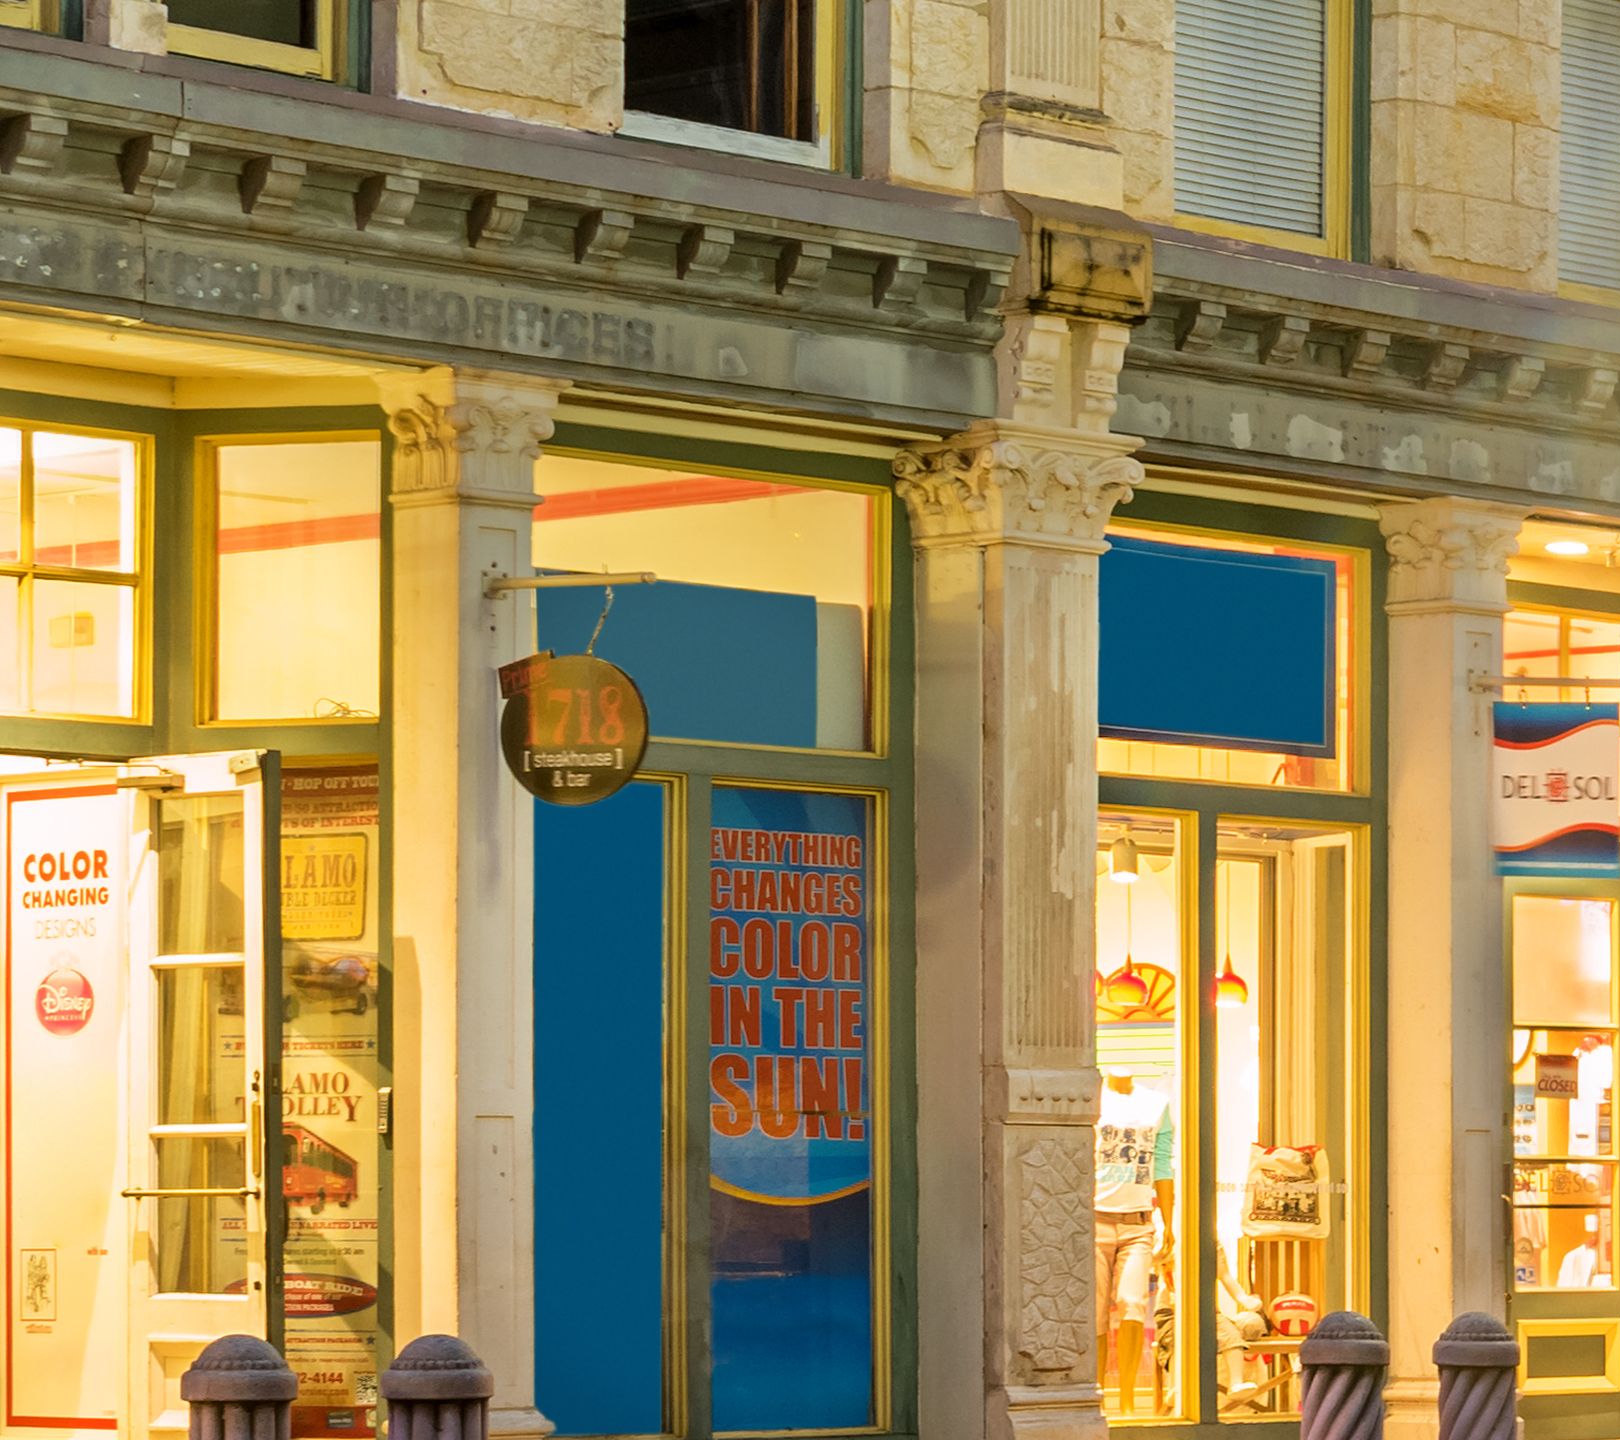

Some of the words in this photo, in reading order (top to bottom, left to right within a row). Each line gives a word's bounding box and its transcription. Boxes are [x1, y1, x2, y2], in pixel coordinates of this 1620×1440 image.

[525, 685, 624, 745] 1718
[324, 777, 349, 789] OFF
[553, 771, 563, 786] &
[566, 772, 592, 786] bar
[1502, 774, 1541, 799] DEL
[1573, 775, 1616, 801] SOL
[710, 828, 862, 868] EVERYTHING
[24, 850, 109, 882] COLOR
[284, 854, 356, 888] LAMO
[23, 887, 109, 909] CHANGING
[710, 868, 862, 917] CHANGES
[35, 917, 96, 939] DESIGNS
[710, 917, 862, 981] COLOR
[710, 986, 760, 1047] IN
[772, 987, 862, 1050] THE
[282, 1072, 349, 1094] AMO
[710, 1053, 865, 1140] SUN!
[1538, 1079, 1577, 1092] CLOSED
[325, 1282, 363, 1295] RIDE
[297, 1372, 343, 1383] 2-4144
